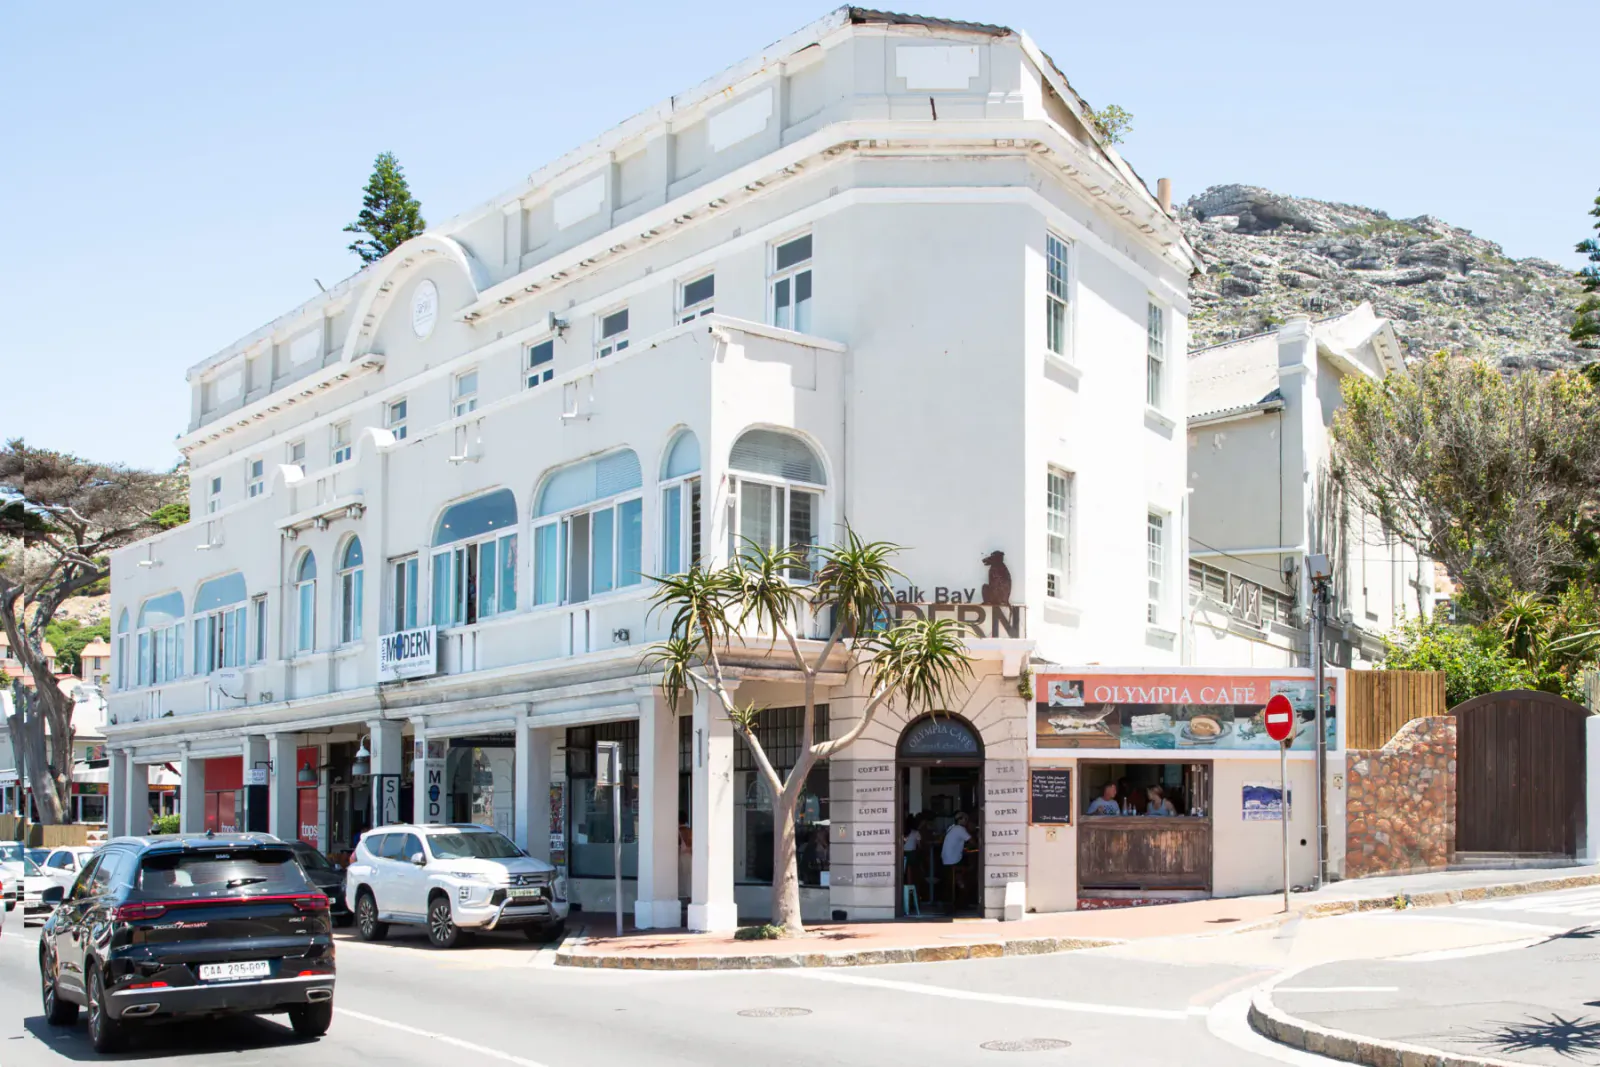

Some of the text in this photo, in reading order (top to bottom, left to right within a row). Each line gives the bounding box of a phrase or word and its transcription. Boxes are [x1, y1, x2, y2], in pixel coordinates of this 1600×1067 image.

[880, 586, 976, 604] Kalk Bay
[386, 629, 431, 663] MODERN
[1094, 681, 1256, 704] OLYMPIA CAFÉ
[909, 725, 948, 748] OLYMPIA
[858, 765, 889, 773] COFFEE
[996, 766, 1015, 774] TEA
[428, 770, 442, 823] MOD
[988, 787, 1024, 795] BAKERY
[859, 807, 888, 815] LUNCH
[302, 821, 319, 837] tops
[856, 829, 891, 837] DINNER
[856, 871, 891, 879] MUSSELS
